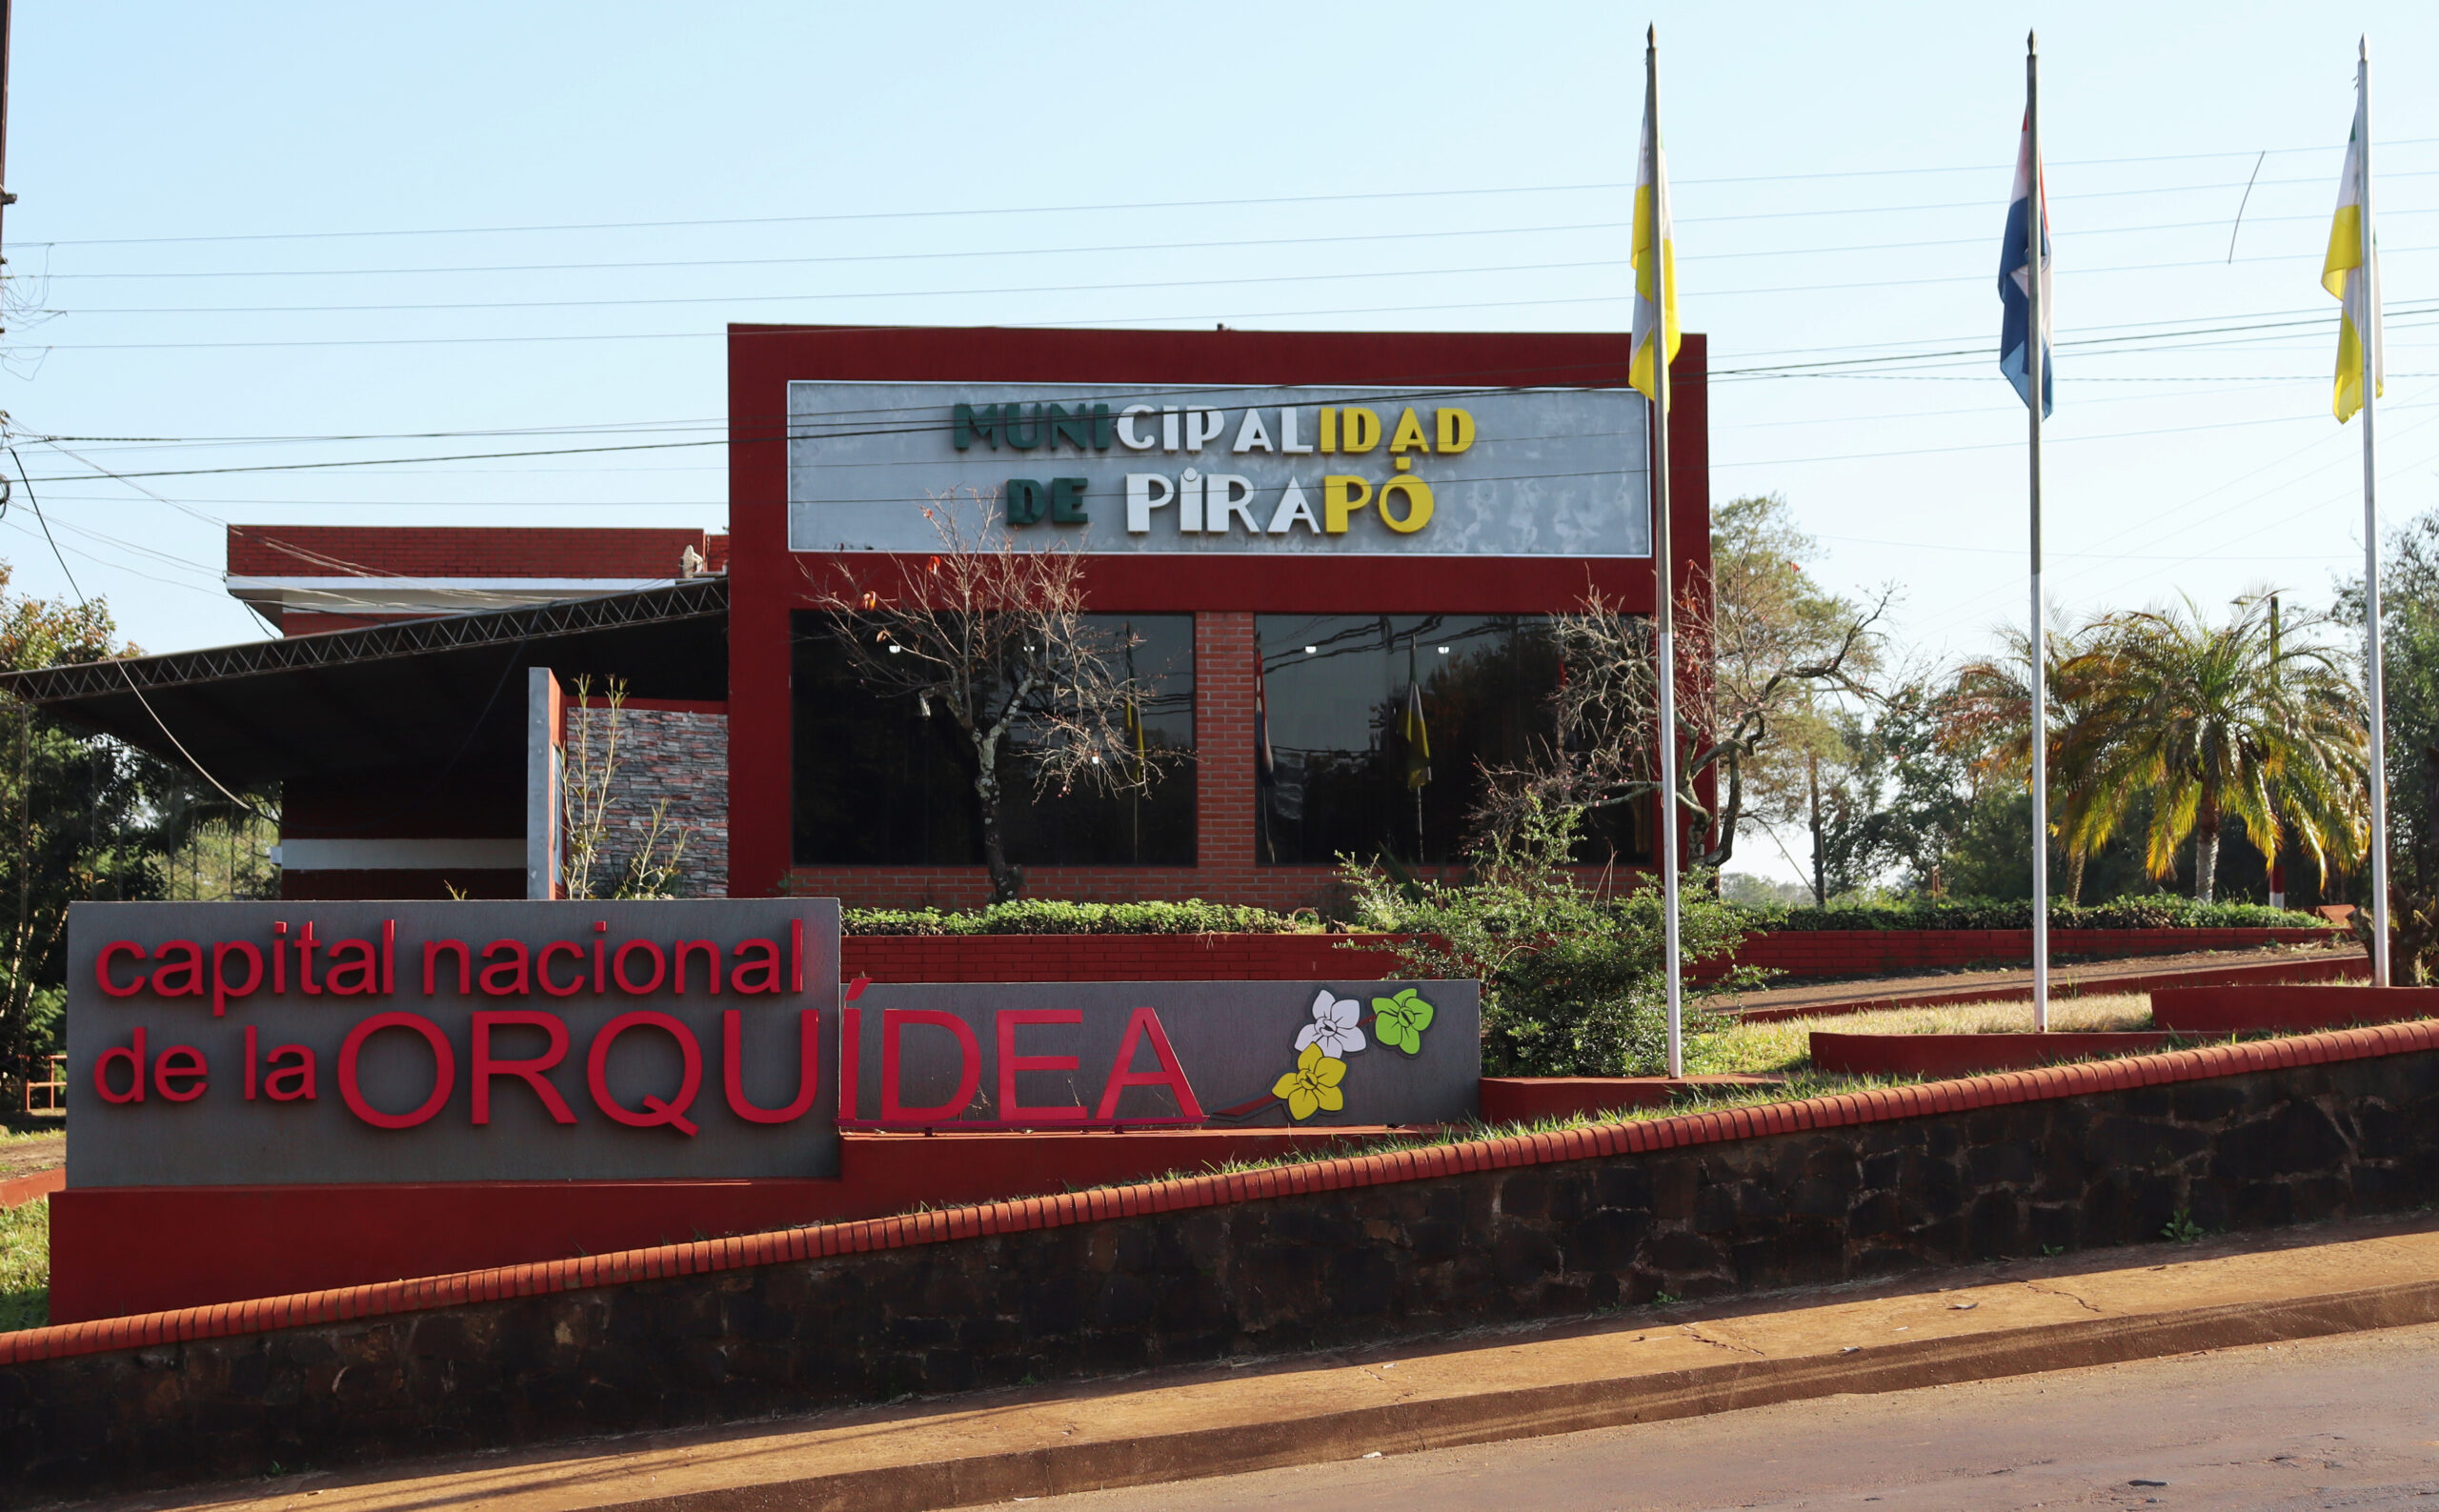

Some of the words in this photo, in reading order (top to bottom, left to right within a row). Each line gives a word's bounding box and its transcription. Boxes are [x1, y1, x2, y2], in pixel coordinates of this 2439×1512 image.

[953, 402, 1476, 454] MUNICIPALIDAD
[1005, 477, 1089, 525] DE
[93, 918, 395, 1017] capital
[422, 918, 803, 997] nacional
[92, 1026, 209, 1103] de
[244, 1025, 318, 1101] la
